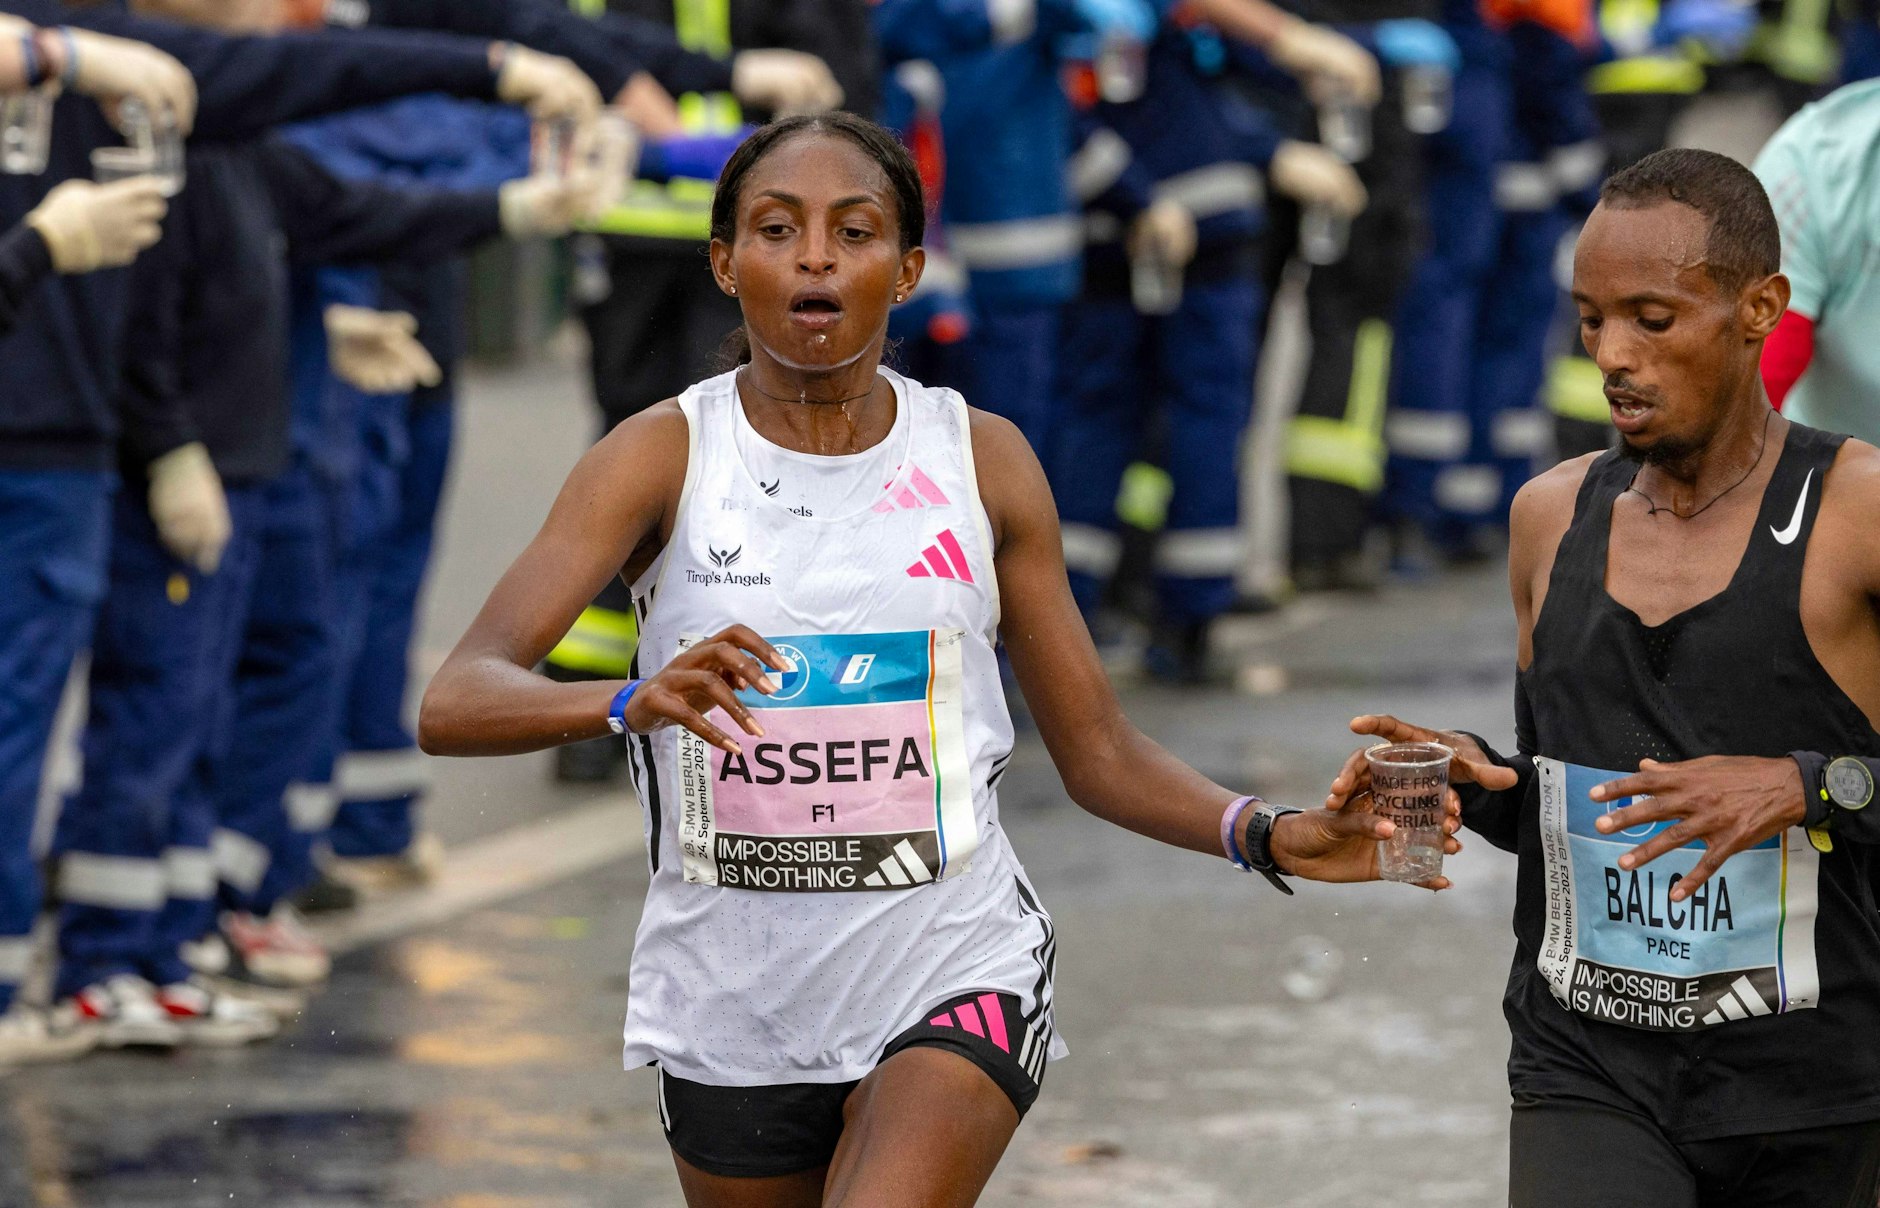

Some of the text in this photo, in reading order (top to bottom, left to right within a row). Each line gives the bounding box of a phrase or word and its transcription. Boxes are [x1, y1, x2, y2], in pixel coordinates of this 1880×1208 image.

[686, 569, 771, 587] Tirop's Angels
[682, 728, 695, 797] BERLIN-M
[718, 736, 930, 786] ASSEFA
[694, 740, 710, 860] 24. September 2023
[1372, 772, 1447, 790] MADE FROM
[684, 799, 696, 836] BMW
[811, 804, 835, 823] F1
[717, 837, 862, 863] IMPOSSIBLE
[1543, 783, 1561, 921] BERLIN-MARATHON
[720, 863, 857, 888] IS NOTHING
[1604, 866, 1735, 932] BALCHA
[1545, 920, 1562, 959] BMW
[1553, 865, 1574, 985] 24. September 2023
[1646, 936, 1691, 960] PACE
[1574, 963, 1700, 1003] IMPOSSIBLE
[1572, 988, 1697, 1029] IS NOTHING
